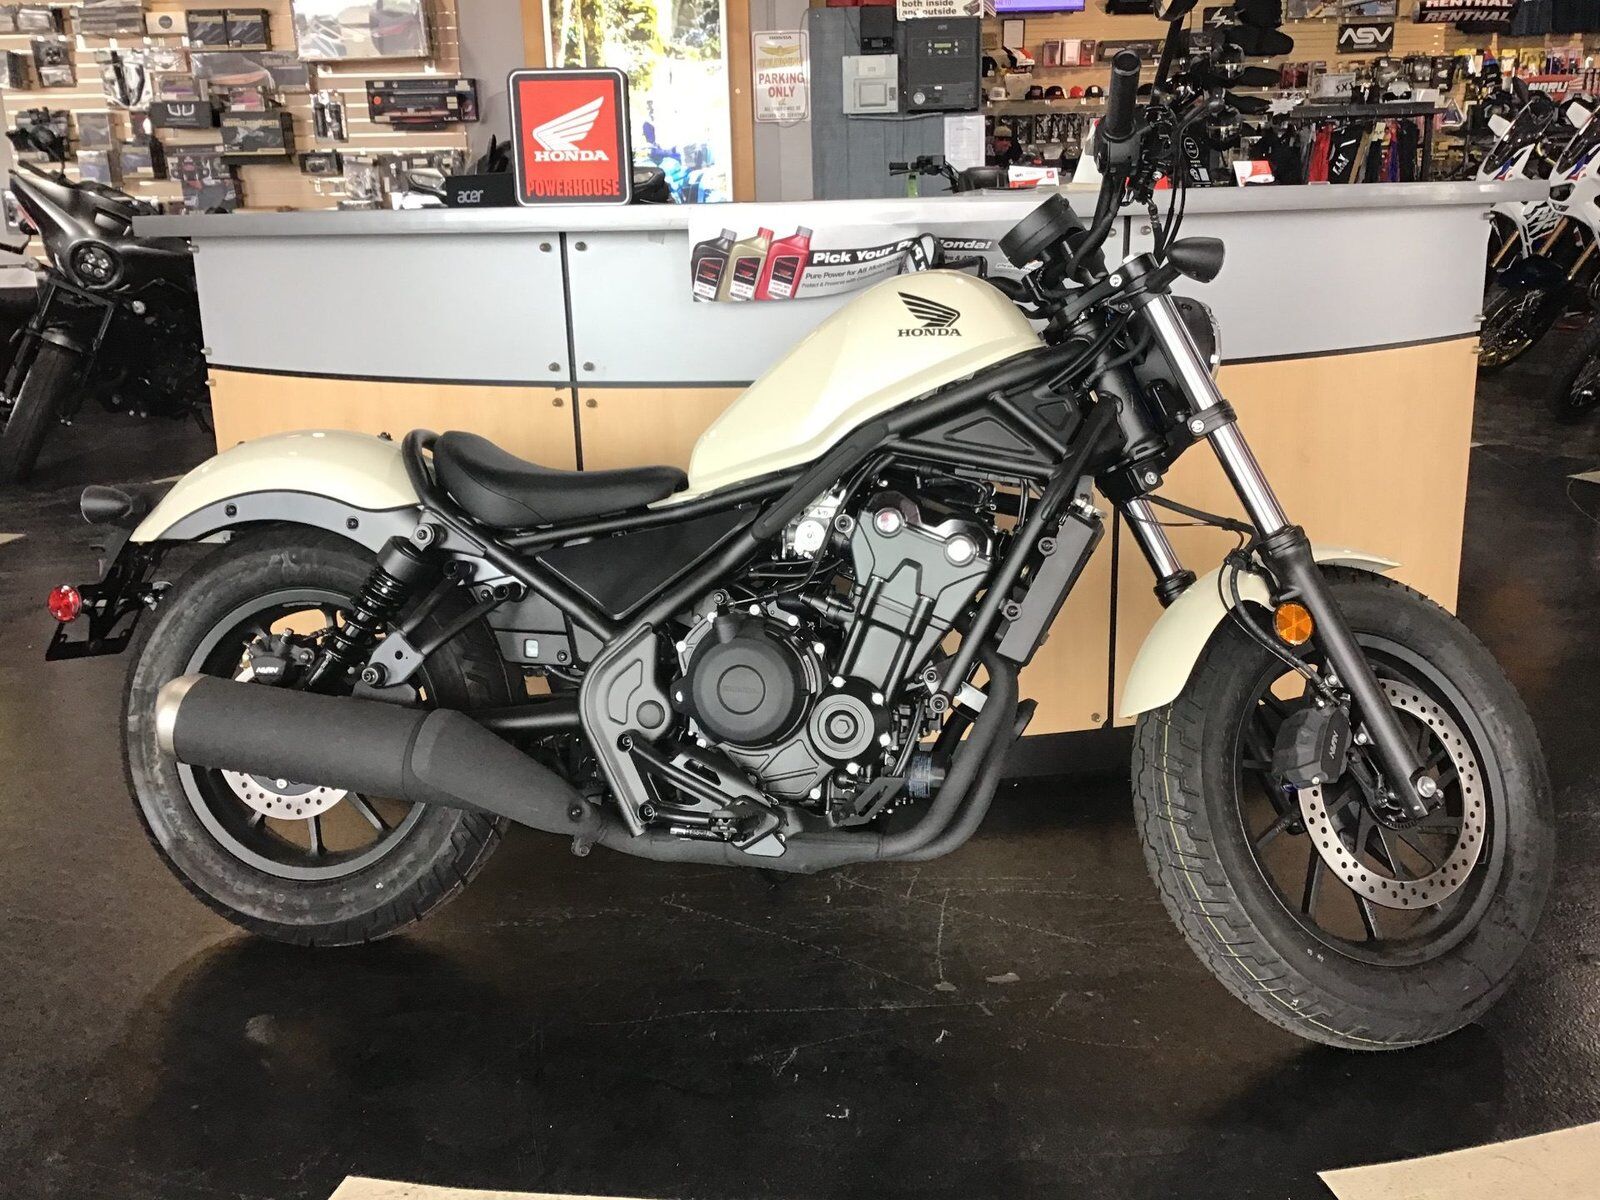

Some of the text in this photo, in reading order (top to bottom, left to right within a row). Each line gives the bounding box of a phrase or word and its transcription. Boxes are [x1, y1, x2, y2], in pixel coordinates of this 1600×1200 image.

[1424, 11, 1510, 22] RENTHAL
[1339, 26, 1392, 44] ASV
[759, 72, 805, 84] PARKING
[768, 86, 795, 98] ONLY
[534, 150, 609, 162] HONDA
[526, 178, 620, 197] POWERHOUSE
[457, 189, 484, 204] acer
[812, 251, 852, 264] Pick
[855, 246, 894, 261] Your
[941, 240, 992, 249] onda!
[823, 269, 845, 278] Power
[897, 328, 962, 337] HONDA
